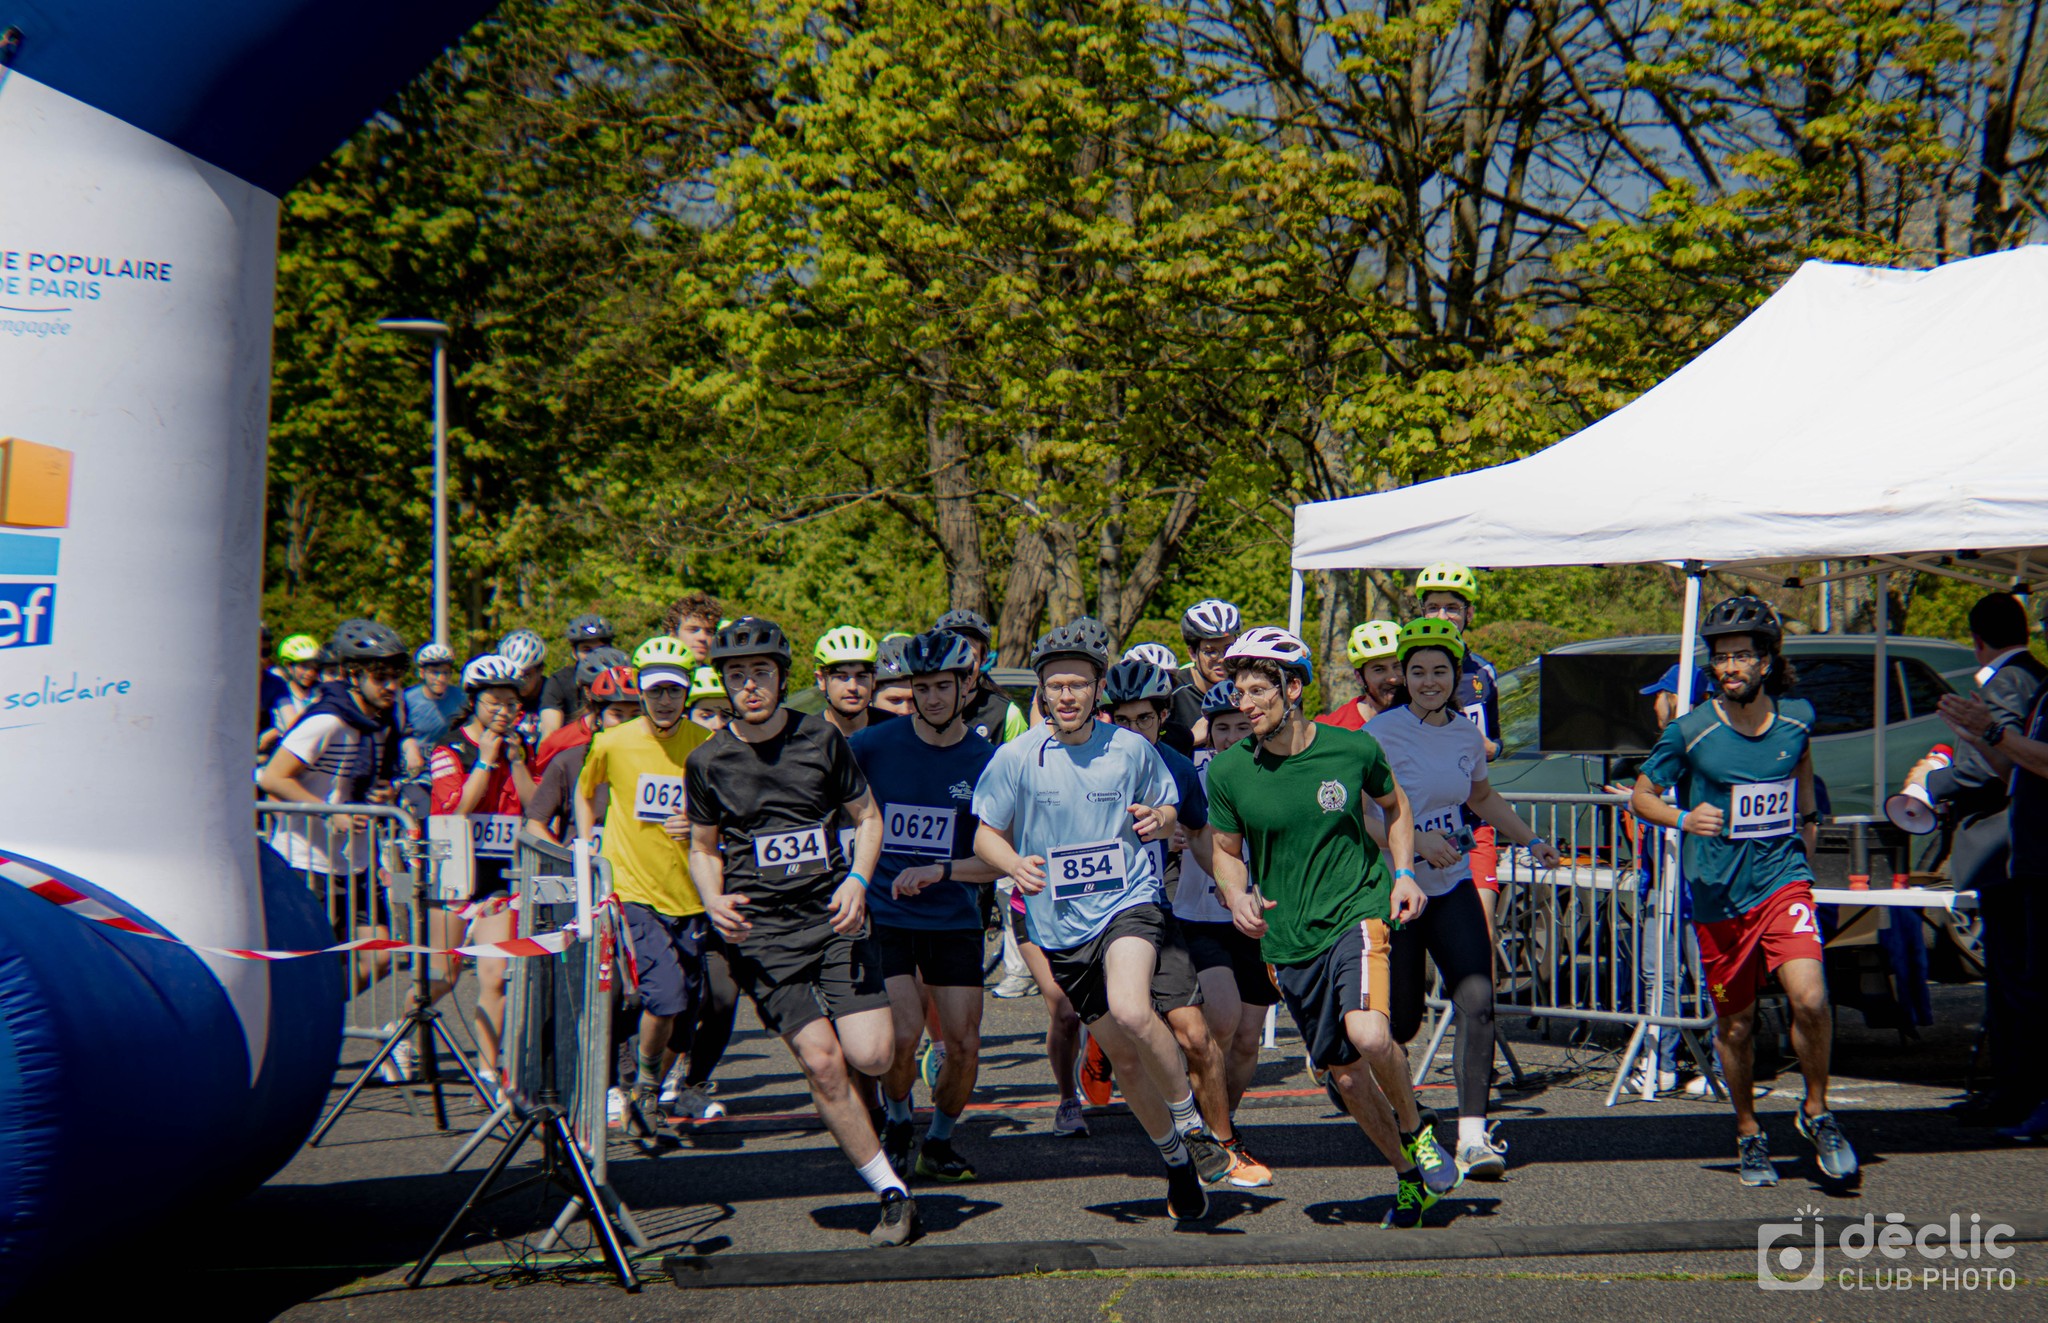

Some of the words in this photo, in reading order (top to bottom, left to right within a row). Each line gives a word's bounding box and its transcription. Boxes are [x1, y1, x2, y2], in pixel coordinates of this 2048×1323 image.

[0, 251, 20, 270] E
[28, 252, 173, 283] POPULAIRE
[0, 276, 21, 295] E
[28, 277, 101, 300] PARIS
[4, 671, 131, 710] solidaire
[1740, 790, 1789, 817] 0622
[473, 821, 515, 844] 0613
[891, 812, 949, 841] 0627
[764, 832, 820, 862] 634
[1063, 854, 1113, 880] 854
